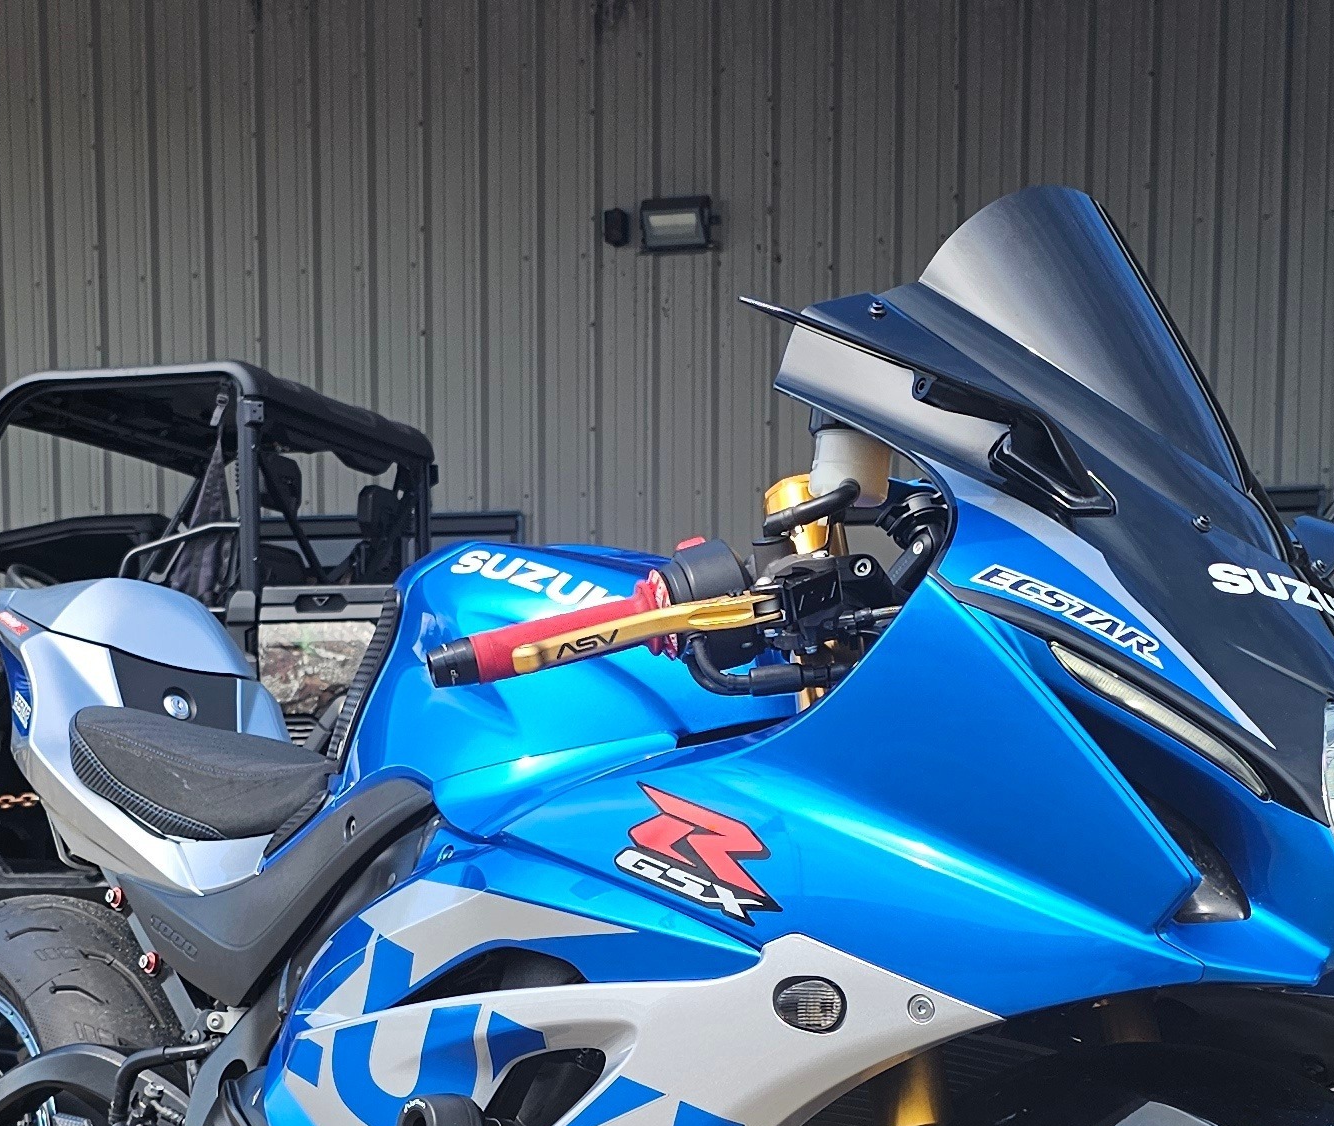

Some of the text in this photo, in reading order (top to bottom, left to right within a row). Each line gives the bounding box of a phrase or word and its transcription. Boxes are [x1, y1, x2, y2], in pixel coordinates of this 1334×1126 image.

[450, 550, 628, 607] SUZUK
[556, 628, 619, 660] ASV
[969, 564, 1164, 670] ECSTAR
[629, 781, 768, 899] R
[614, 848, 765, 919] GSX
[150, 915, 198, 959] 1000
